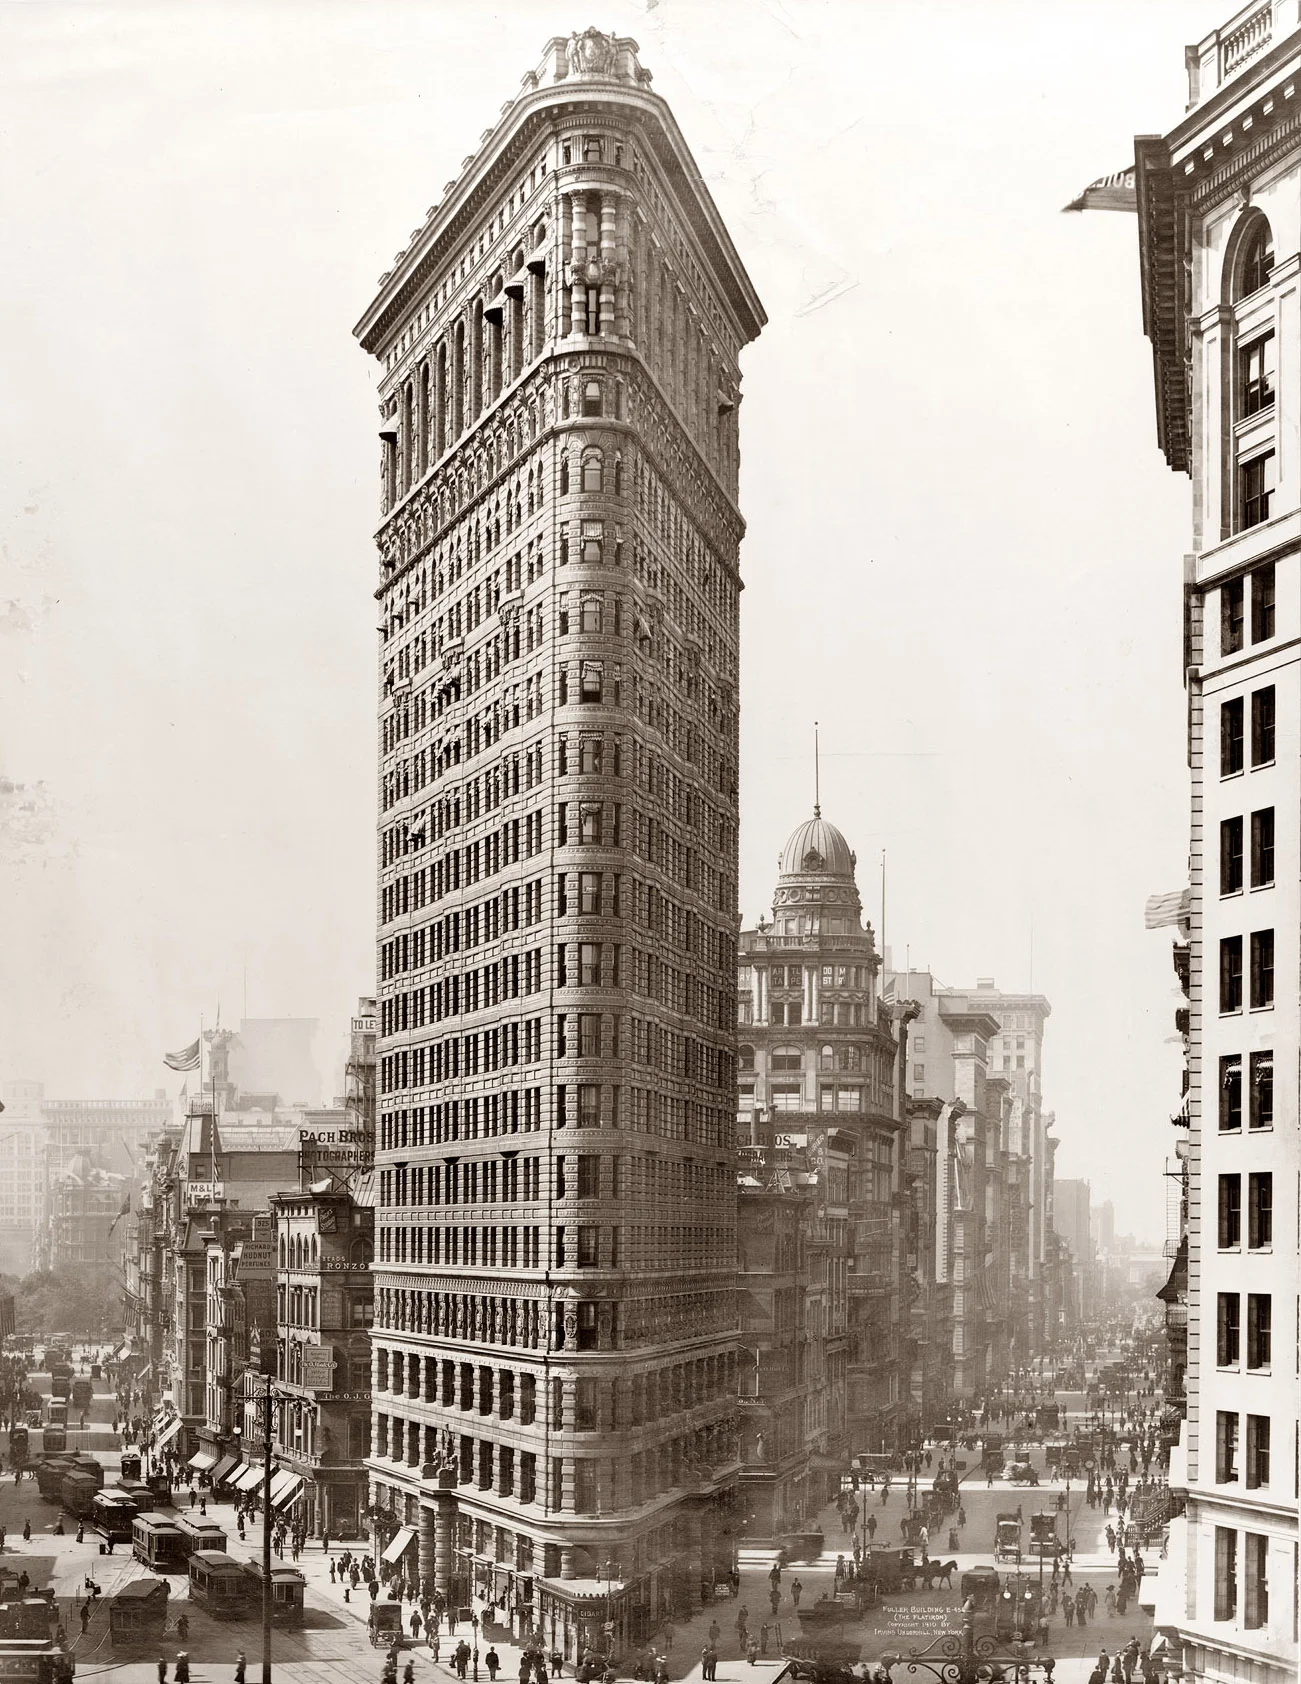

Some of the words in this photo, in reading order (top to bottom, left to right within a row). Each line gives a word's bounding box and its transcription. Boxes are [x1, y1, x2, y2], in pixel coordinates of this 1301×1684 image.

[353, 1019, 363, 1030] TO
[365, 1019, 376, 1030] LE
[299, 1129, 336, 1143] PACH
[243, 1251, 271, 1260] HUDNUT
